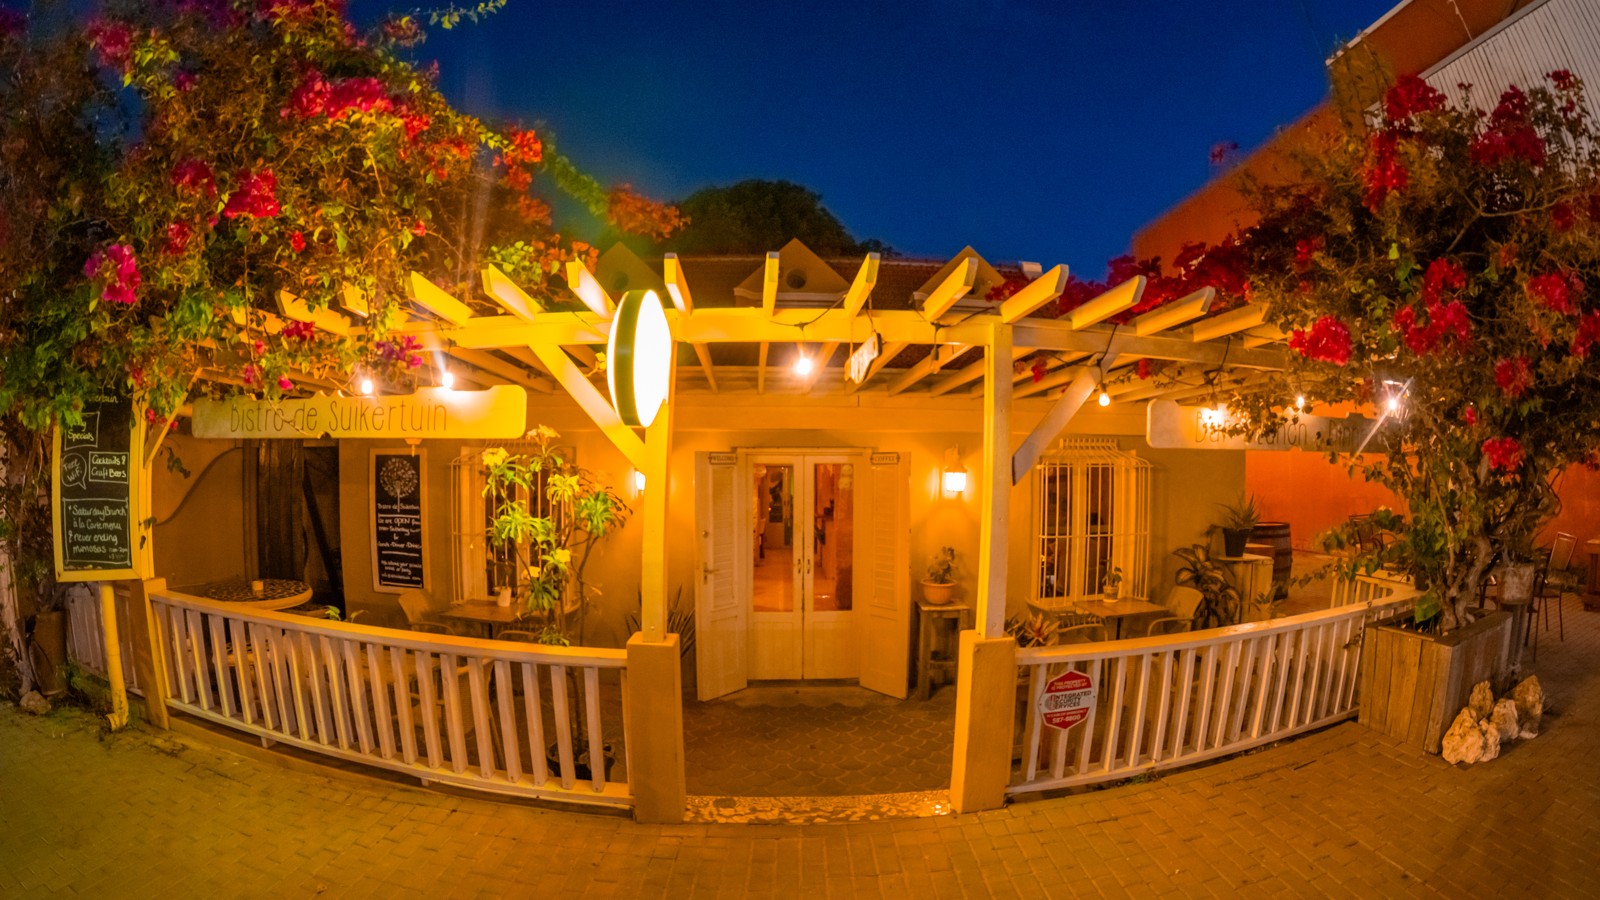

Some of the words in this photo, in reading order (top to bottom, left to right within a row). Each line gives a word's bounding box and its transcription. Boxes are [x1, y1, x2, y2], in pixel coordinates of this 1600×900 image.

[230, 403, 285, 433] Bistro
[293, 402, 318, 432] de
[328, 398, 447, 432] Suikertuin
[93, 533, 118, 546] ending
